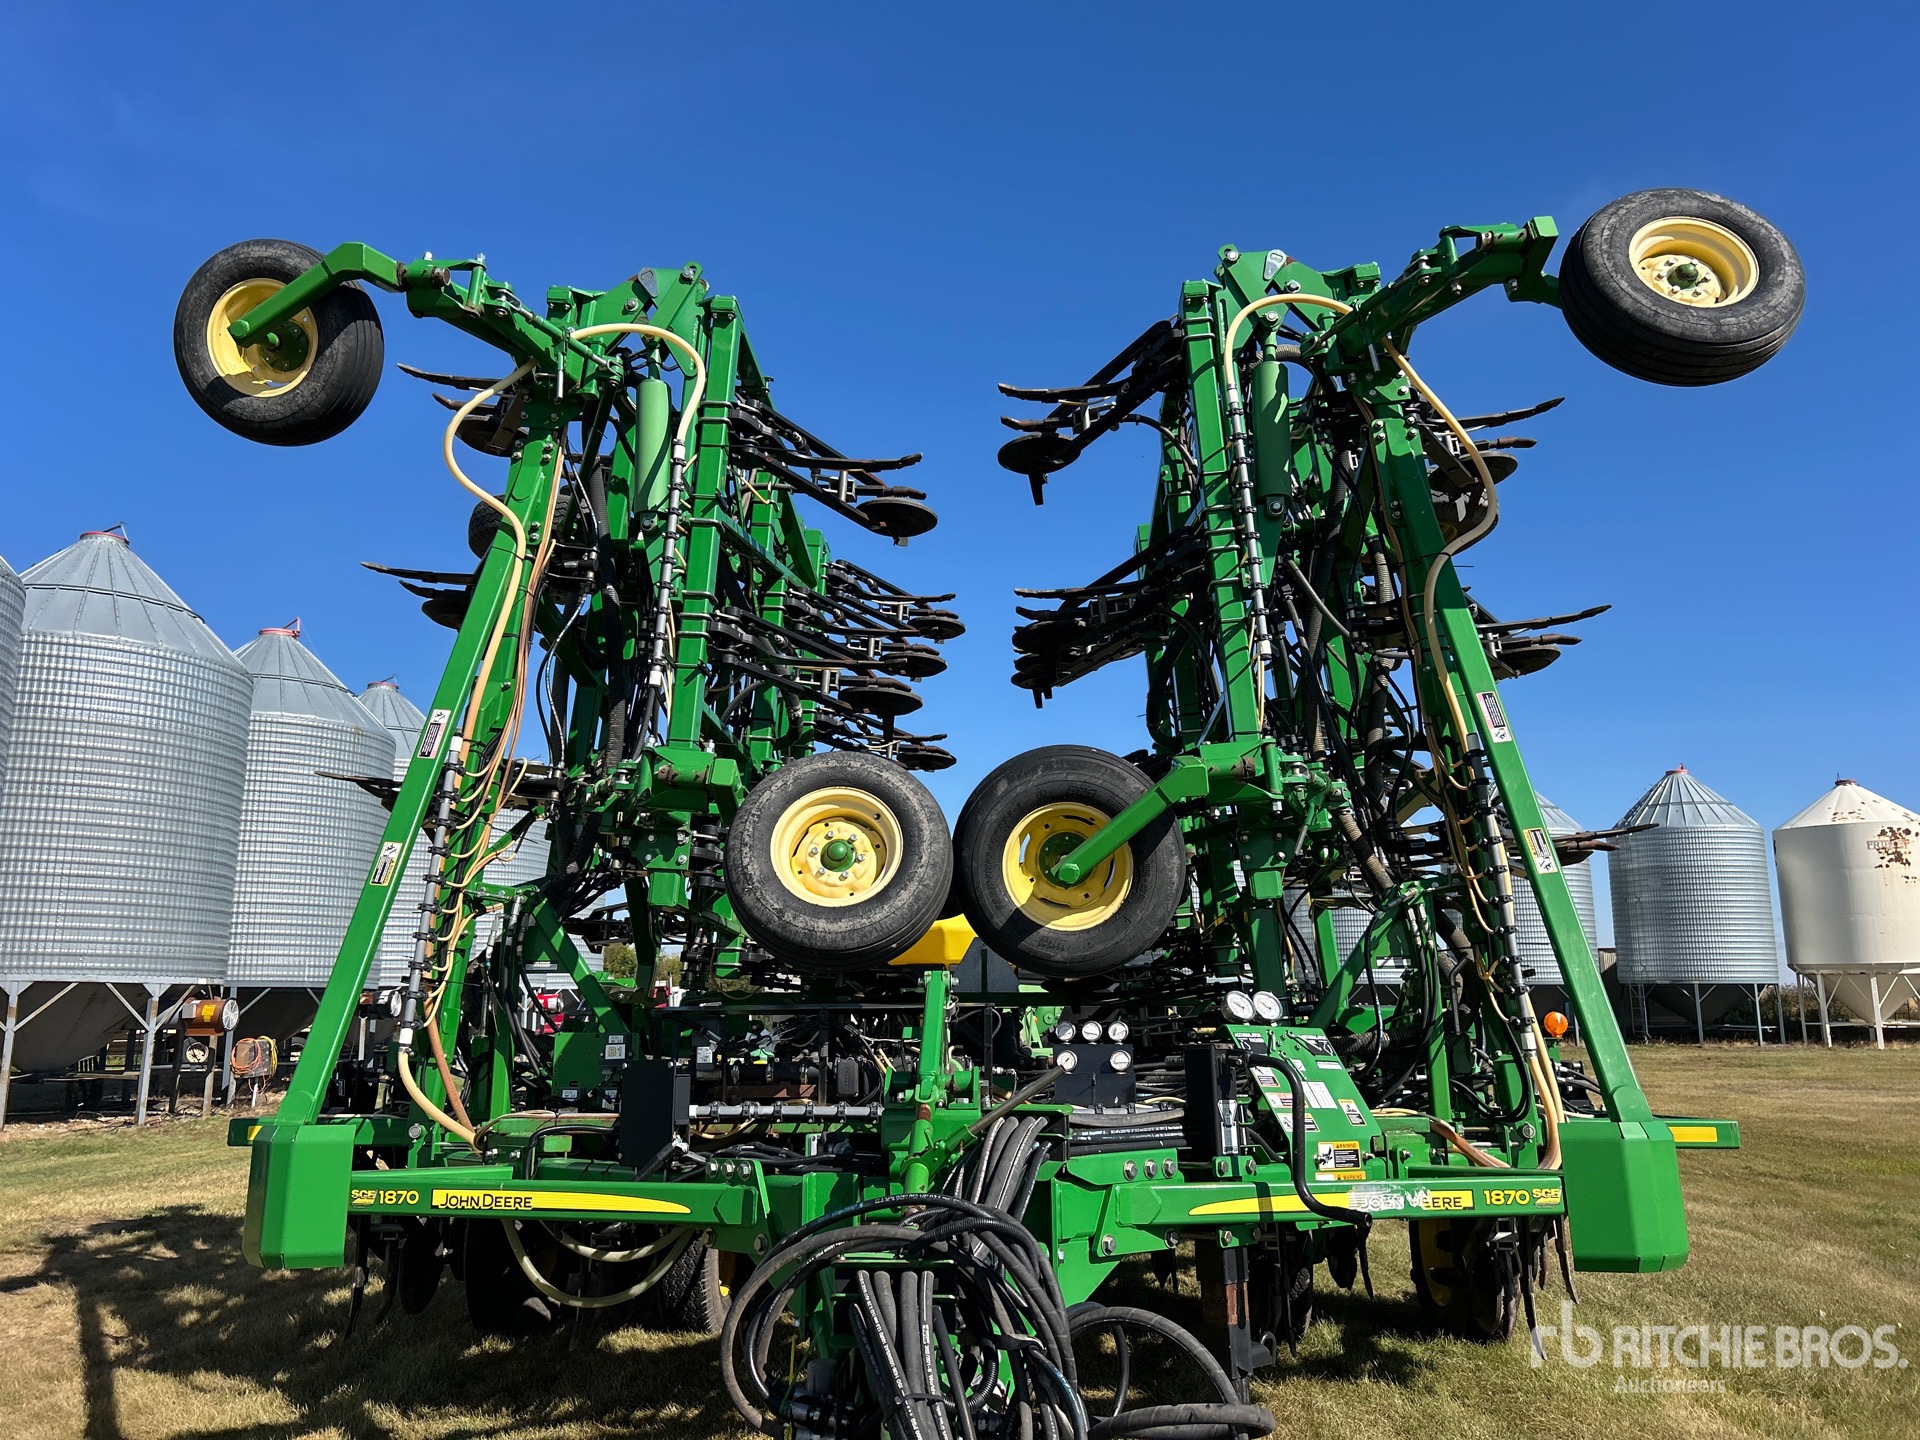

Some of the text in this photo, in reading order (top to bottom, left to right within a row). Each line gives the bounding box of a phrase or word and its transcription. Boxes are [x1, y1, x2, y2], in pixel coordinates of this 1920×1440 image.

[378, 1189, 420, 1205] 1870
[440, 1193, 533, 1208] JOHN DEERE
[1483, 1189, 1530, 1205] 1870
